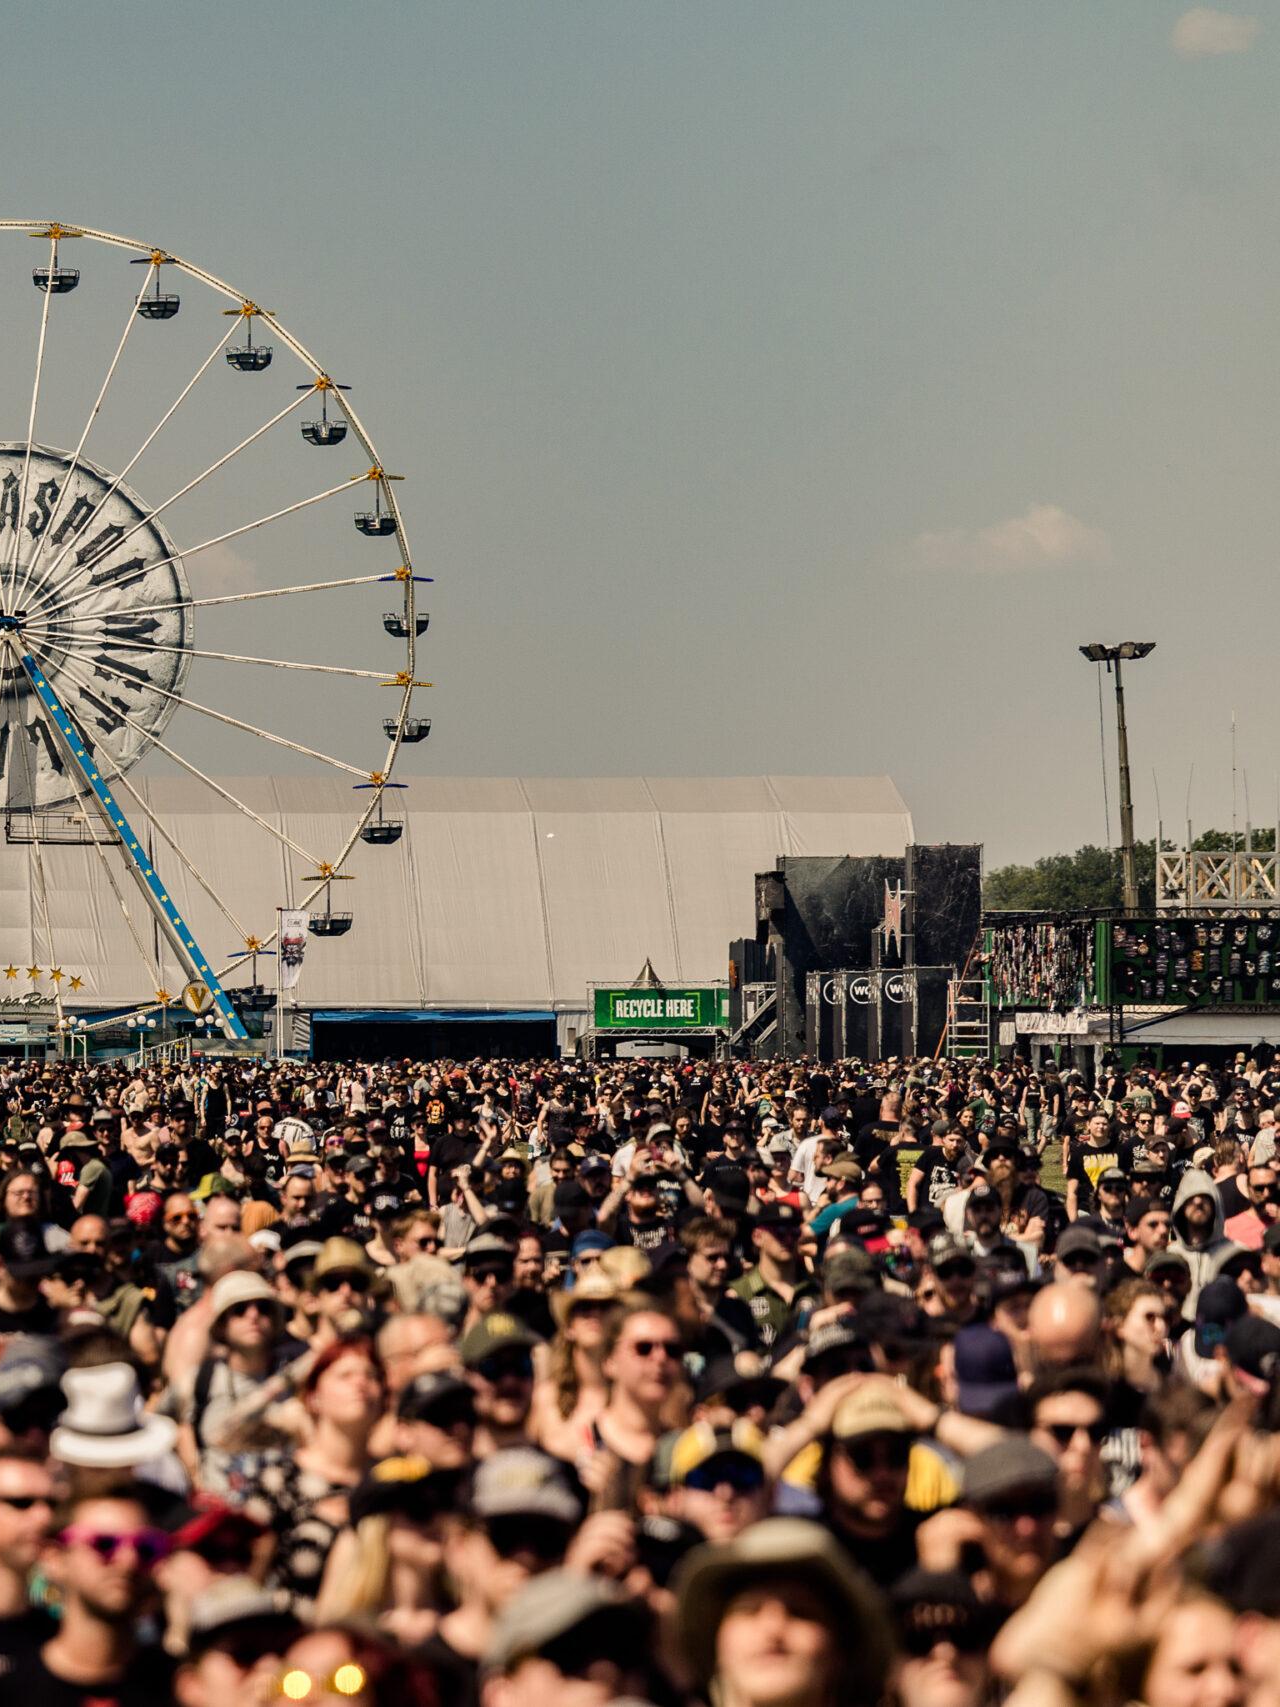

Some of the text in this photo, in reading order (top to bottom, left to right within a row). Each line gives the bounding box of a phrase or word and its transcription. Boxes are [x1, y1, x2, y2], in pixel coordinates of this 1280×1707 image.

[23, 992, 58, 1010] Rad
[615, 998, 695, 1018] RECYCLE HERE
